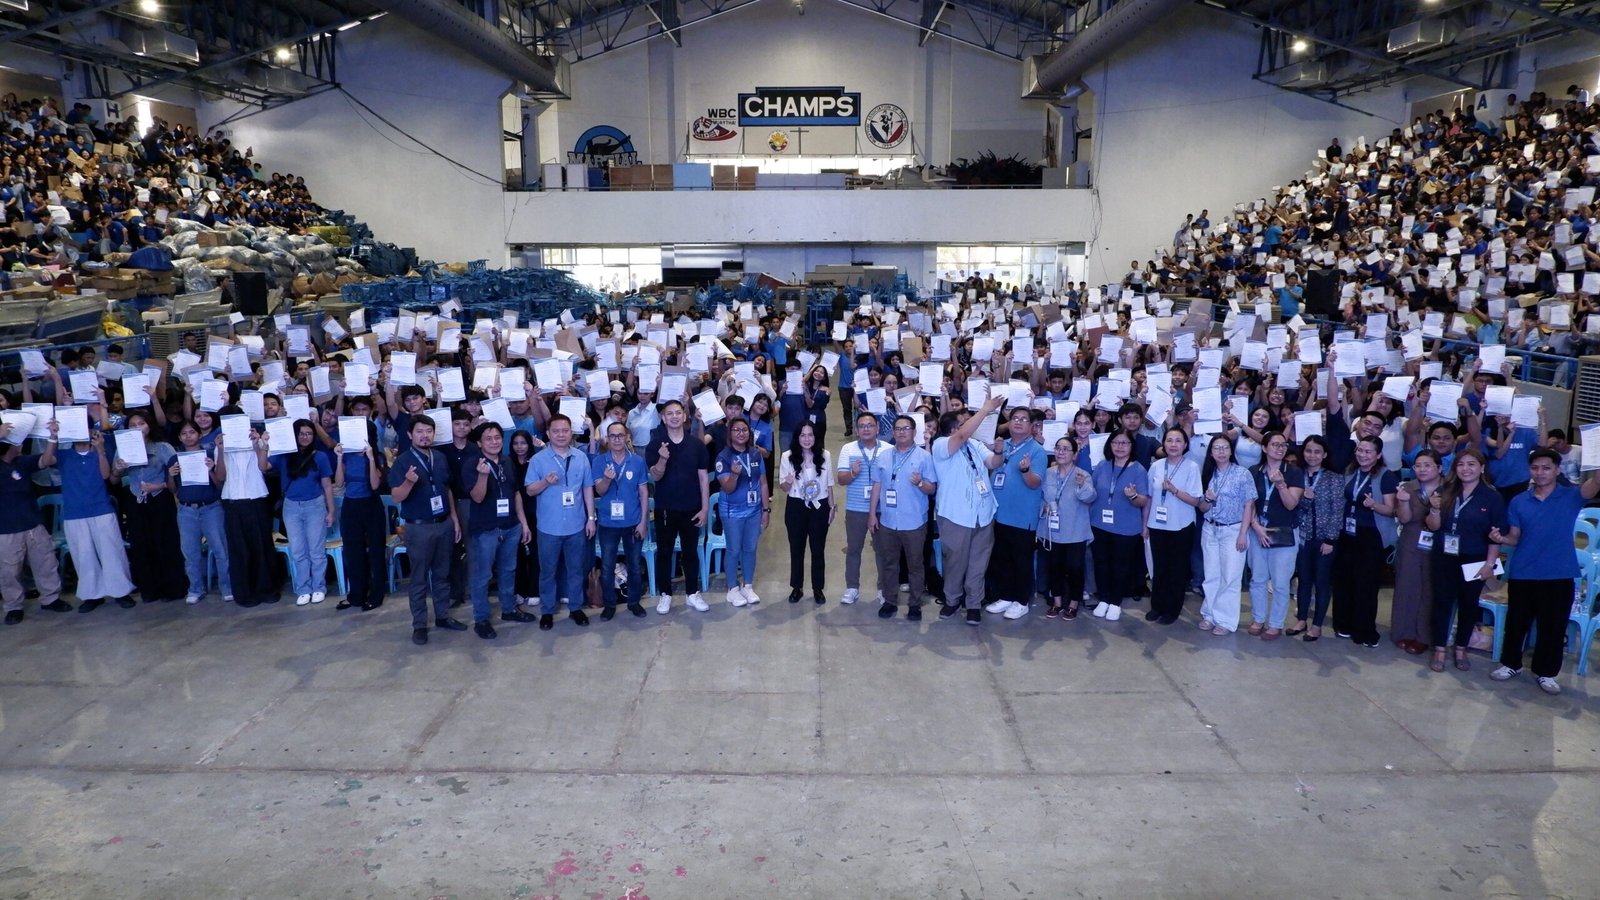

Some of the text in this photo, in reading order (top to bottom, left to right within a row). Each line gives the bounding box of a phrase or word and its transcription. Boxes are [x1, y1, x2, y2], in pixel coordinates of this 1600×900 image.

[106, 102, 119, 119] H
[744, 96, 854, 117] CHAMPS
[1476, 93, 1488, 111] A
[708, 108, 736, 118] WBC
